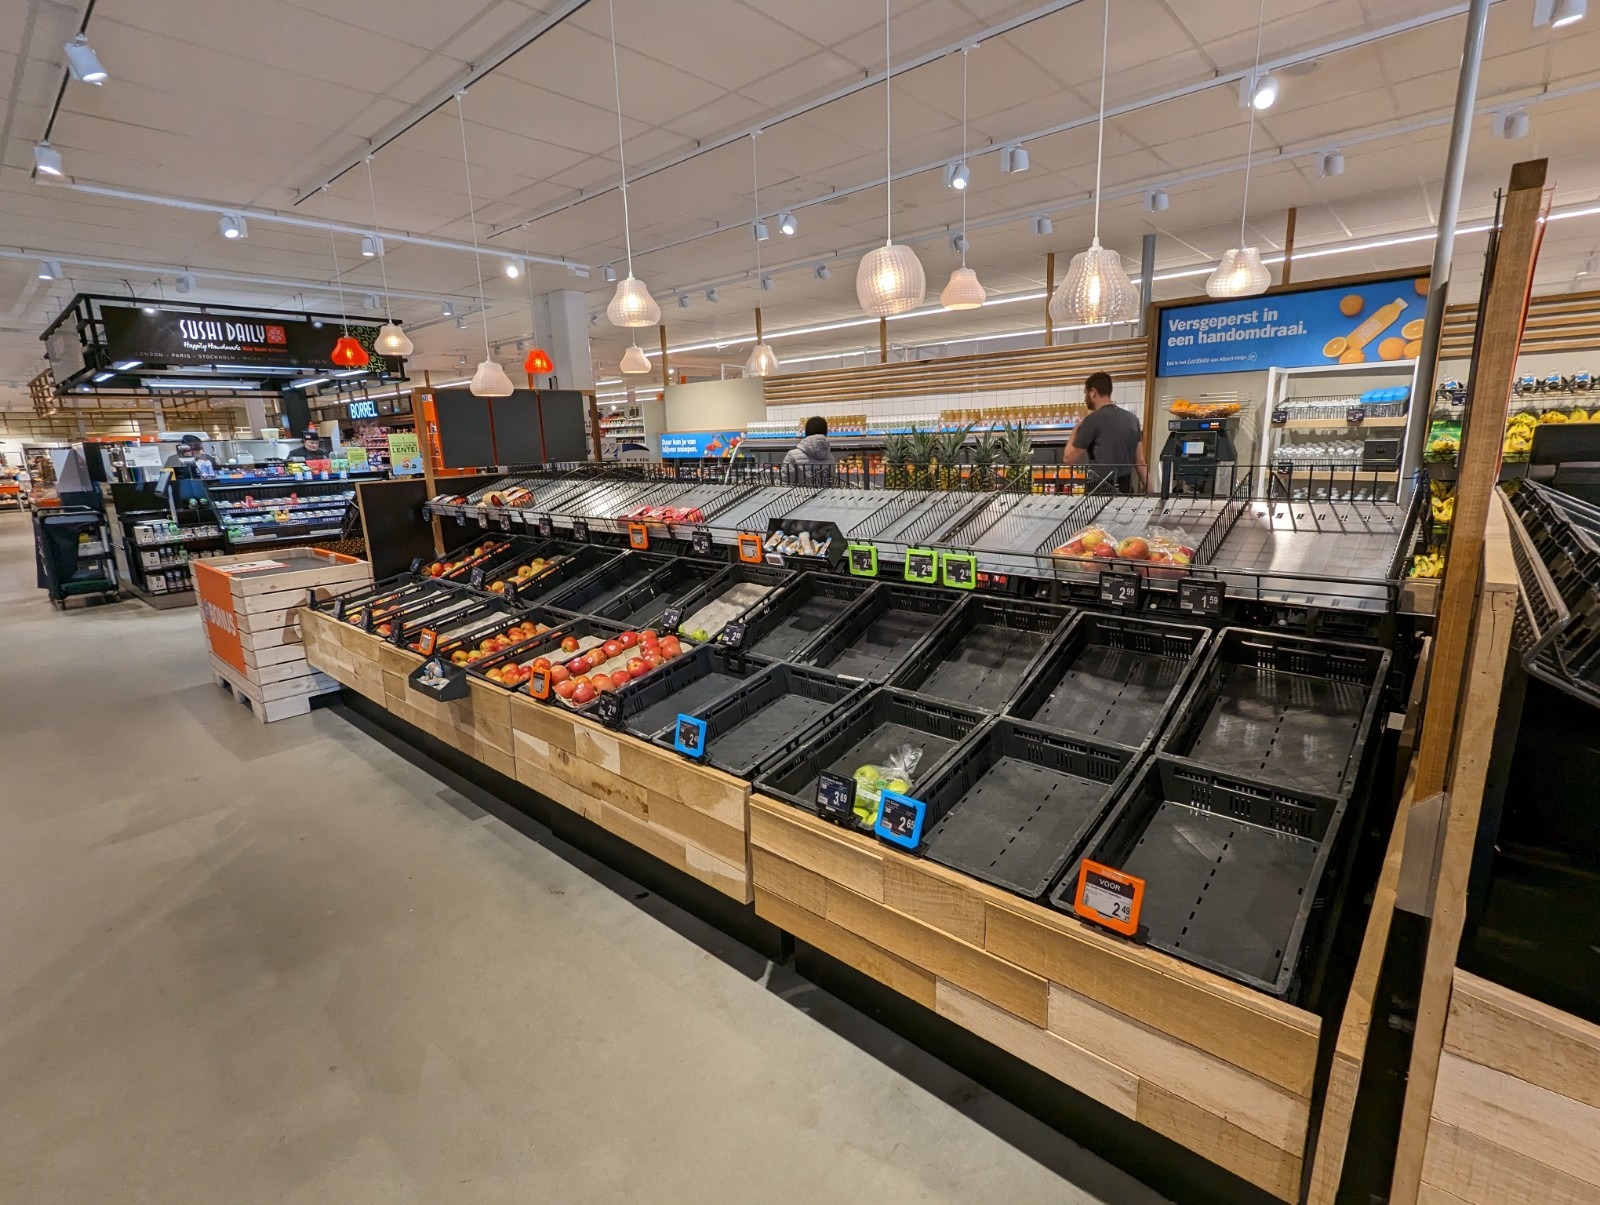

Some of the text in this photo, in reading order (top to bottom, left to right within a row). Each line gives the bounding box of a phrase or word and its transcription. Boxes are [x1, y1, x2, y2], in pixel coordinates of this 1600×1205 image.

[1169, 308, 1278, 331] Versgeperst in
[180, 319, 265, 343] SUSHI DAILY
[1168, 321, 1307, 347] een handomdraai.
[183, 341, 207, 352] Happily
[207, 342, 241, 351] Handmade
[350, 401, 377, 418] BORREL
[1201, 595, 1219, 609] 1.59
[833, 790, 848, 806] 3.69
[1099, 878, 1121, 892] VOOR
[1112, 902, 1131, 918] 2.49
